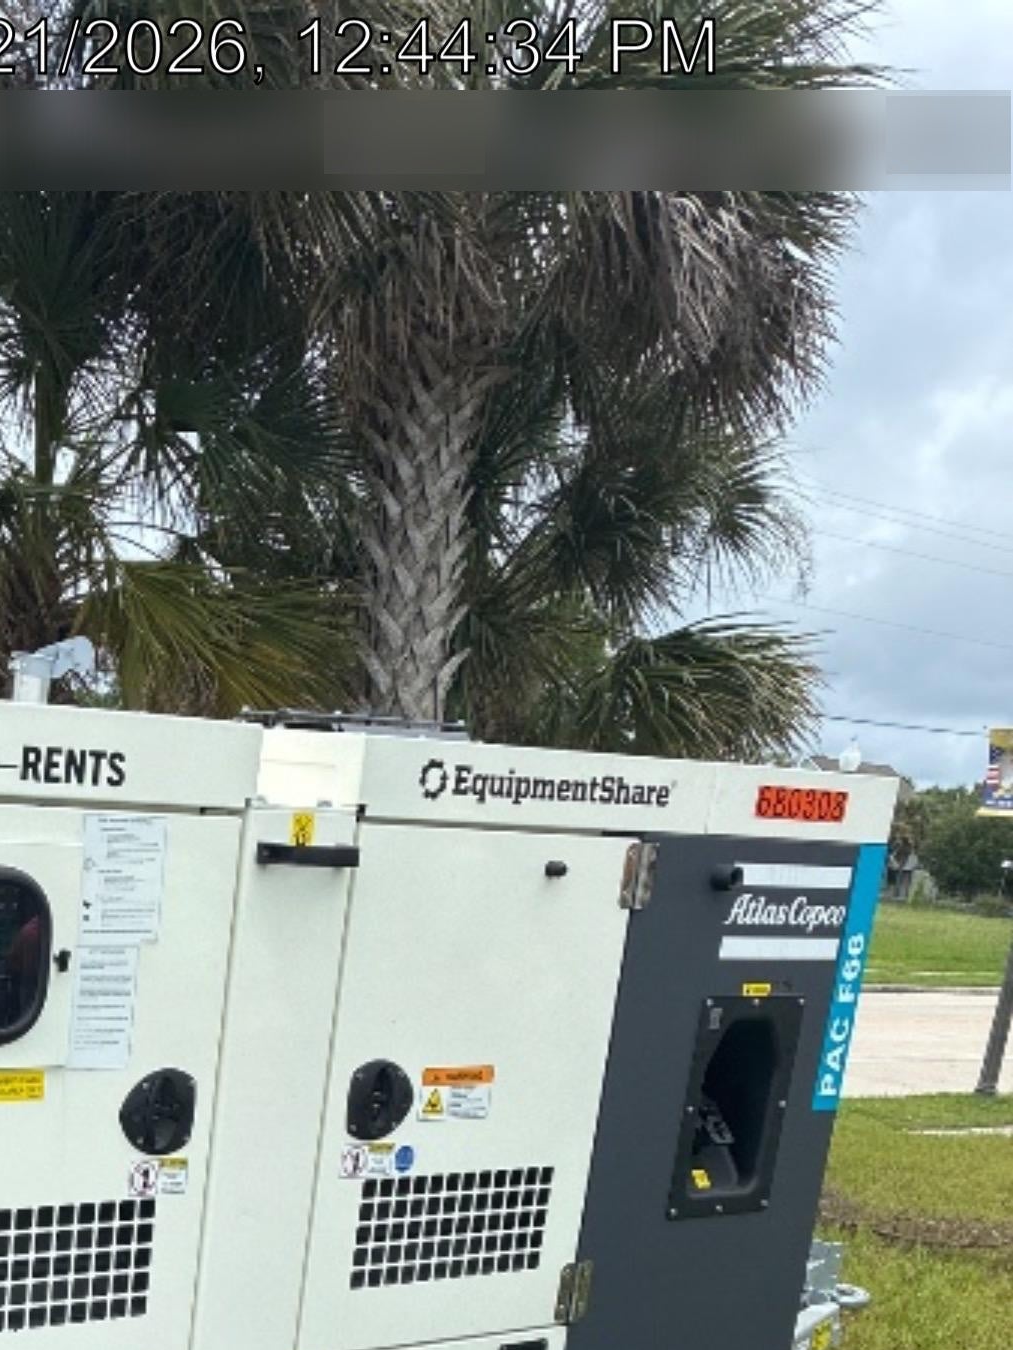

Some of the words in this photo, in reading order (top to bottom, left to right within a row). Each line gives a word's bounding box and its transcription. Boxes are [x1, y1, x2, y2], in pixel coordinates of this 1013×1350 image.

[452, 764, 670, 807] EquipmentShare
[724, 893, 789, 925] Atlas
[788, 896, 846, 934] Copco
[819, 1017, 850, 1097] PAC
